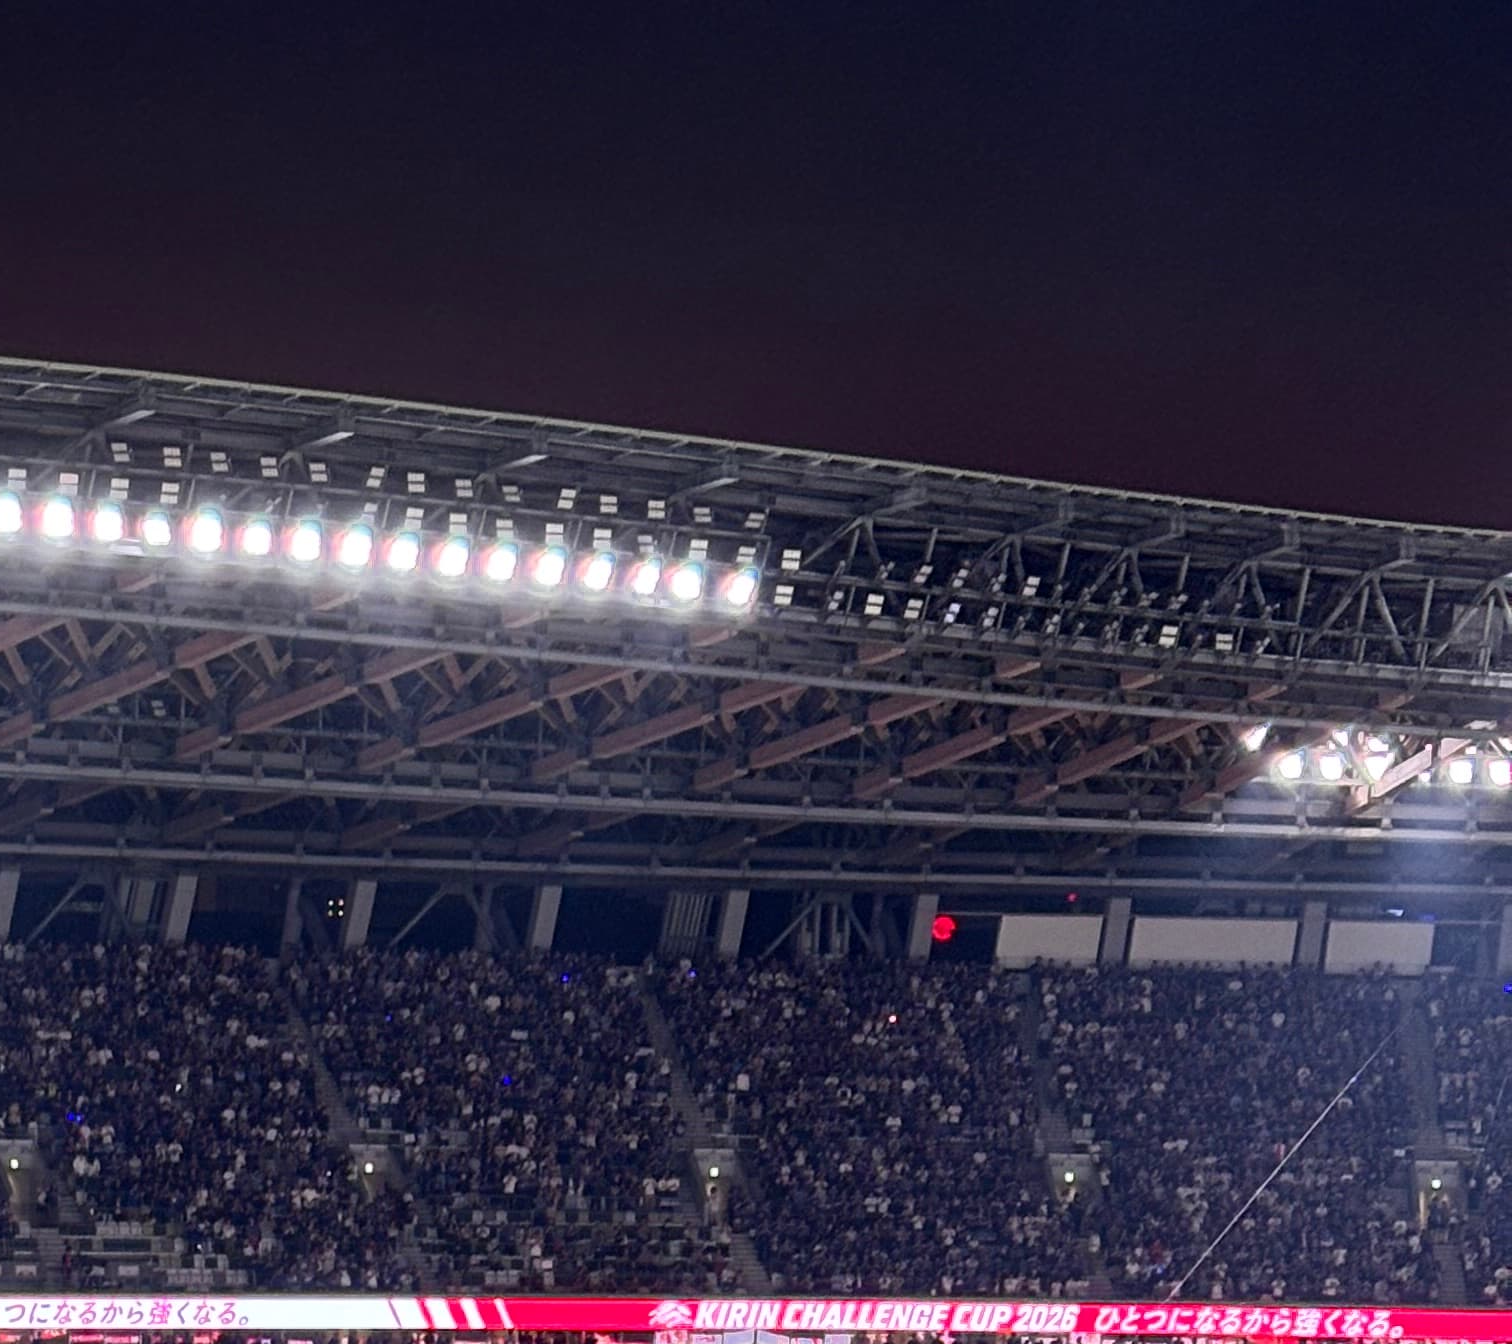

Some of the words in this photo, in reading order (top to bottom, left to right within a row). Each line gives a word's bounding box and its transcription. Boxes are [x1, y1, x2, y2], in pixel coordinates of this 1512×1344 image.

[695, 1300, 781, 1329] KIRIN
[782, 1301, 949, 1331] CHALLENGE
[950, 1303, 1013, 1332] CUP
[1012, 1304, 1081, 1332] 2026
[1094, 1306, 1404, 1340] ひとつになるから強くなる。
